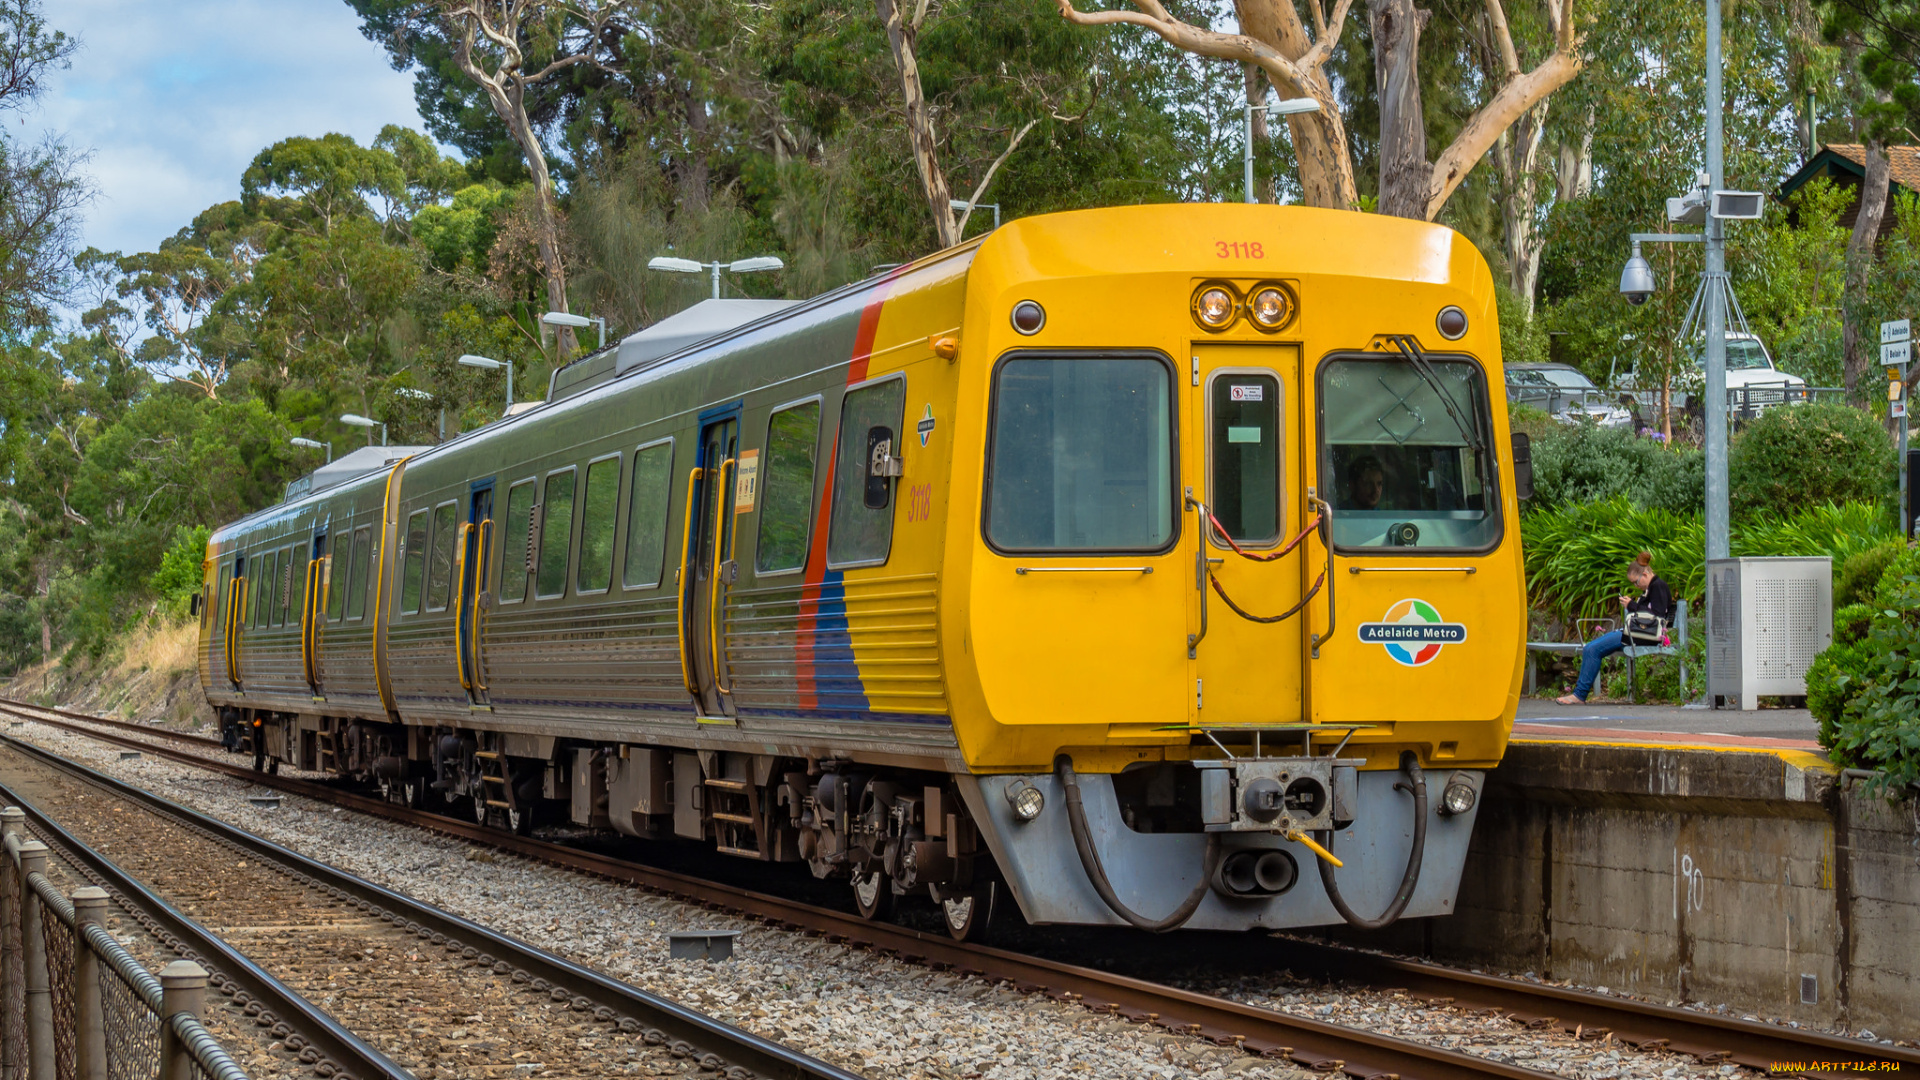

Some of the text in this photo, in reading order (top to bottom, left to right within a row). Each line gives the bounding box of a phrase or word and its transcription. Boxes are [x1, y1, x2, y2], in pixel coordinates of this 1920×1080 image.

[1215, 240, 1264, 259] 3118
[1891, 326, 1908, 336] Adelaide
[1890, 349, 1901, 358] Belair
[908, 483, 931, 522] 3118
[1368, 627, 1458, 638] Adelaide Metro
